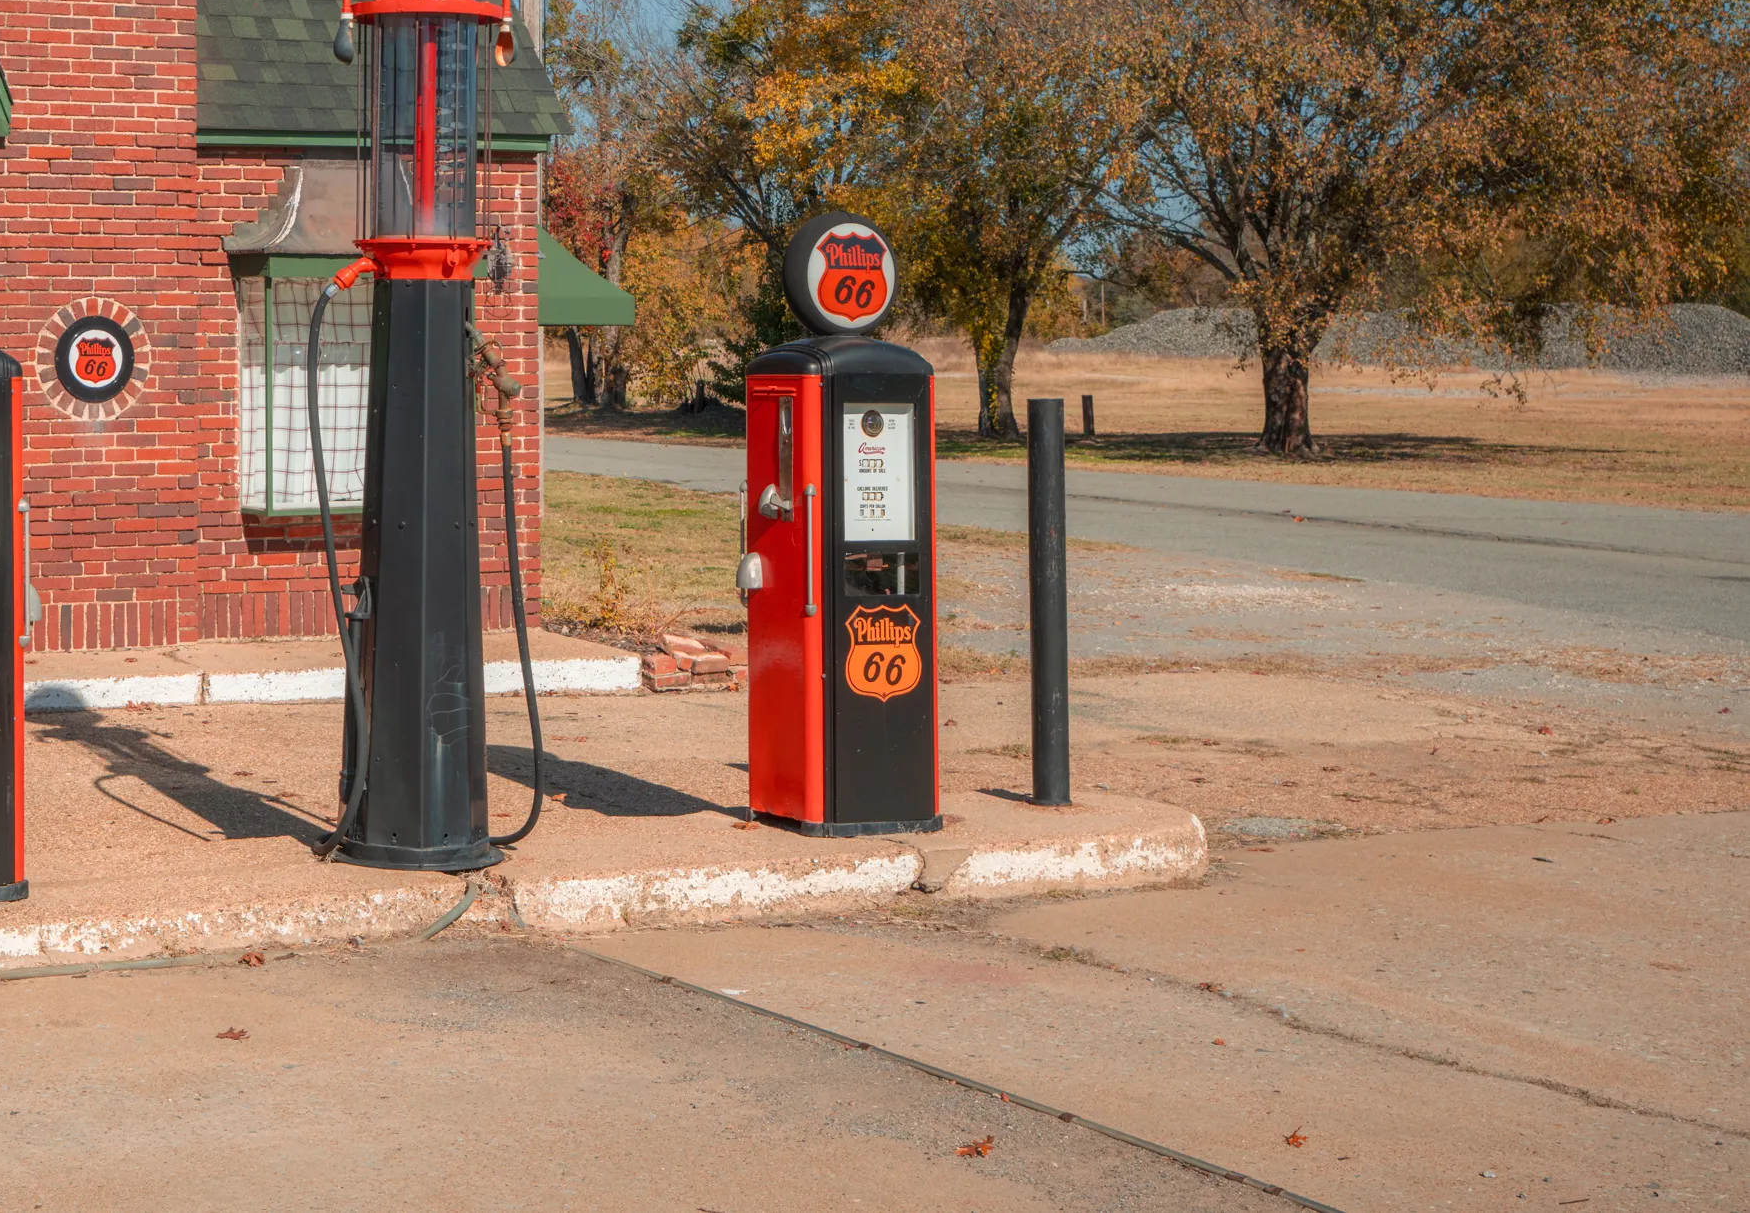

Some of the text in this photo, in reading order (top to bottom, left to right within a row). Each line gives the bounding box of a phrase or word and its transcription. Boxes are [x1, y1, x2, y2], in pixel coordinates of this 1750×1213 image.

[825, 243, 881, 273] Phillips
[834, 275, 875, 309] 66
[79, 341, 111, 357] Phillips
[84, 359, 108, 377] 66
[858, 442, 886, 455] American
[853, 616, 912, 648] Phillips
[863, 651, 906, 686] 66
